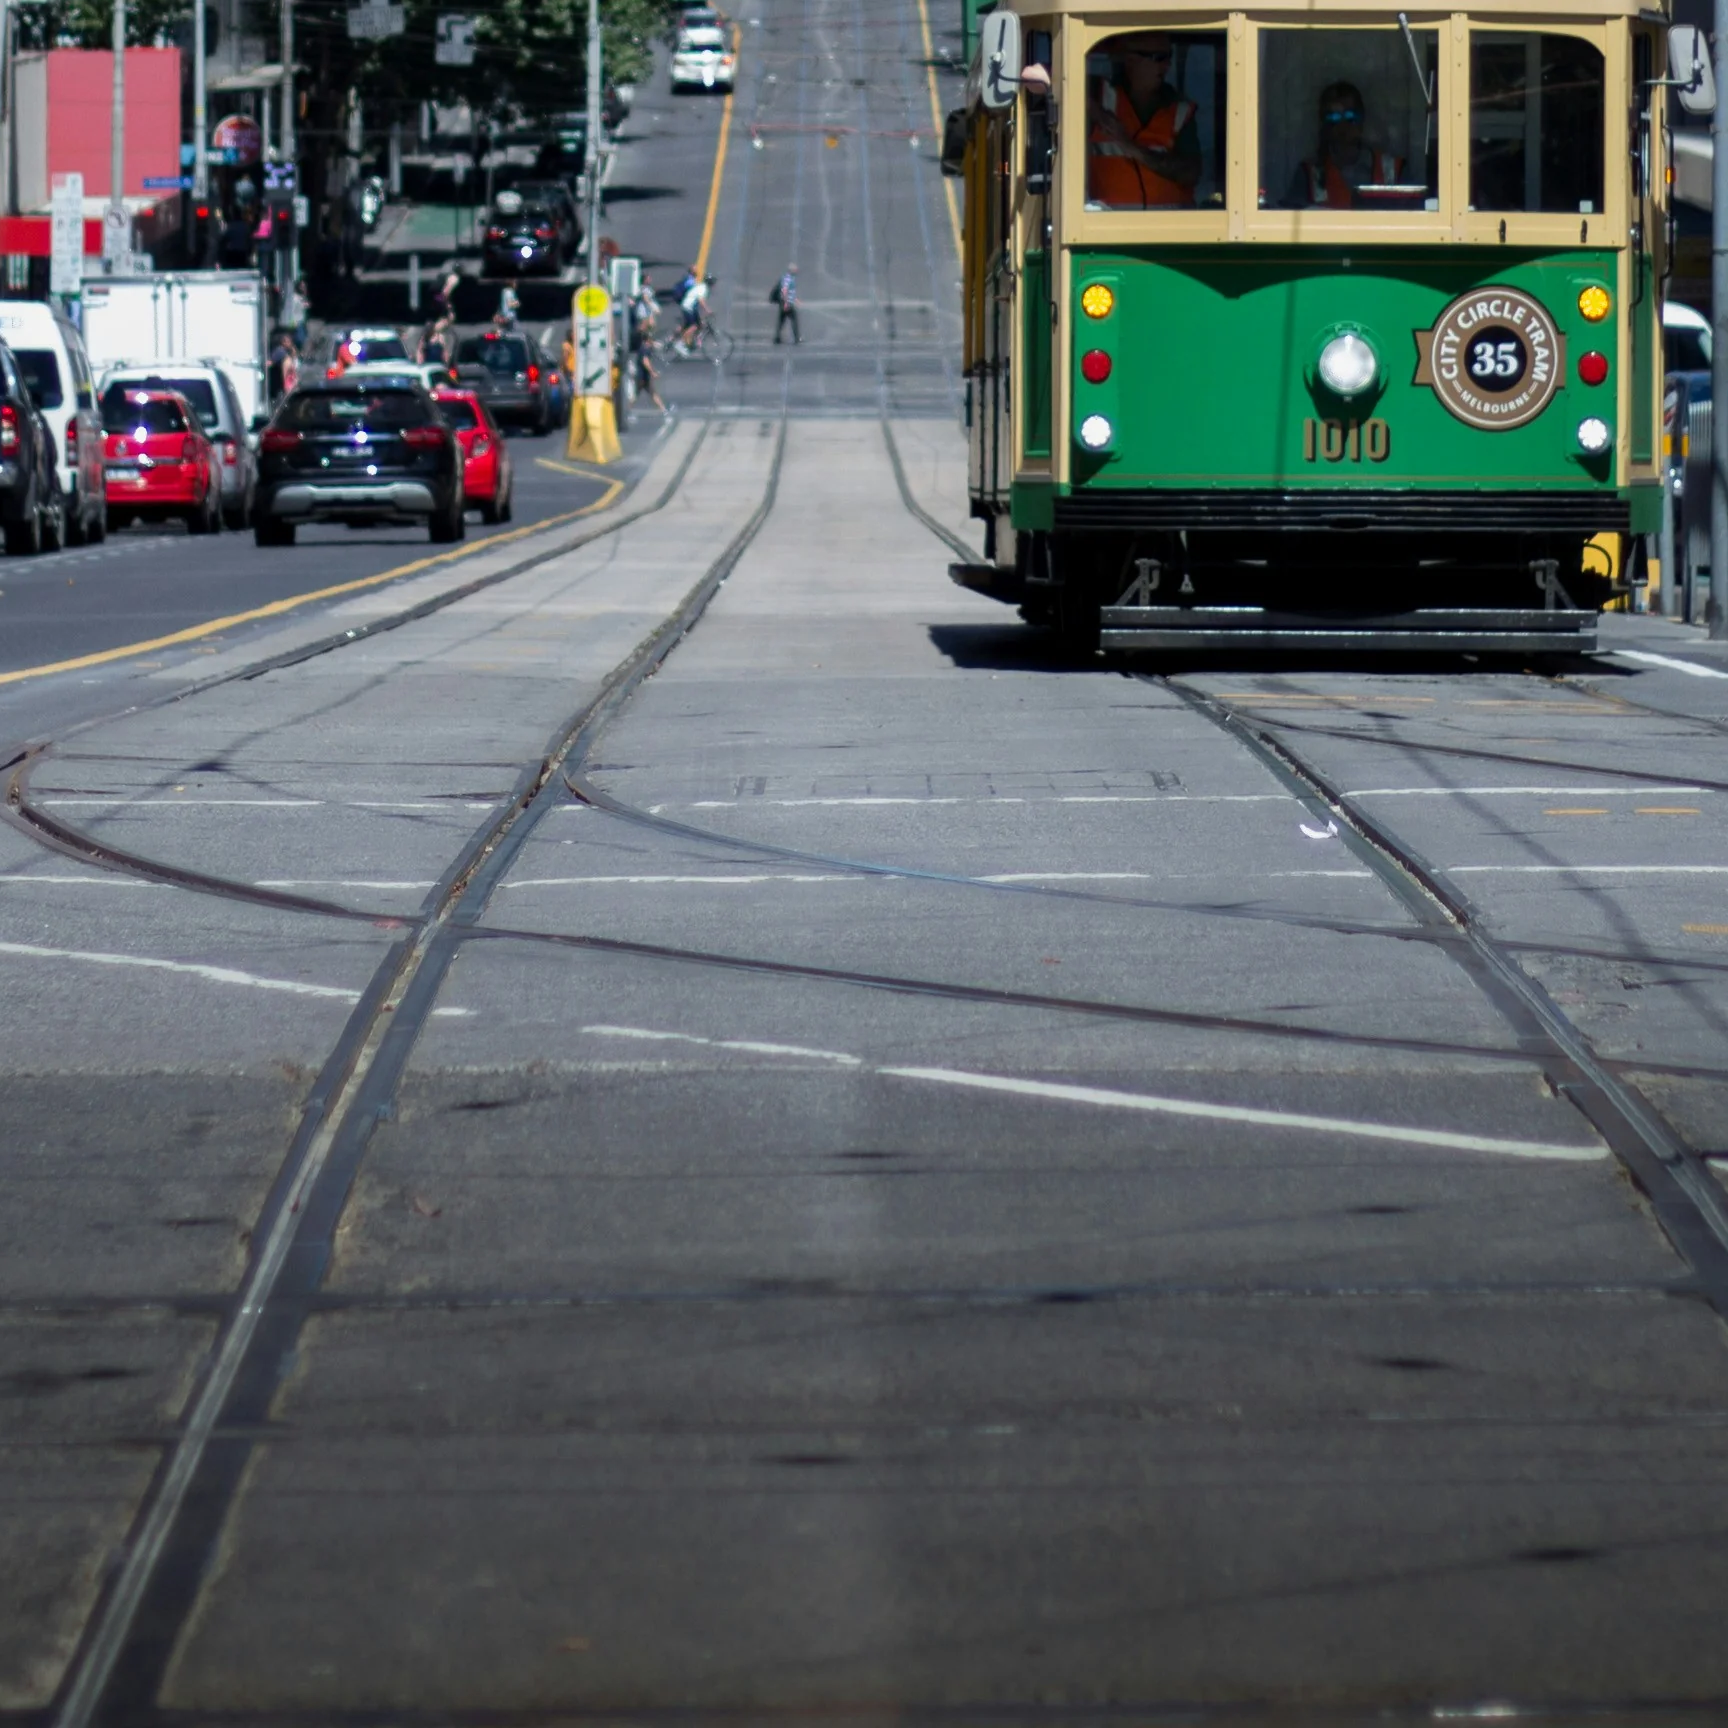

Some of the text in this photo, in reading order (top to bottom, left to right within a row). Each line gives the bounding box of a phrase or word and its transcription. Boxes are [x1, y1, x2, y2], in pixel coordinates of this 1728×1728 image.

[1440, 299, 1550, 383] CITY CIRCLE TRAM
[1472, 342, 1519, 376] 35
[1460, 390, 1530, 414] MELBOURNE
[1303, 418, 1391, 463] 1010
